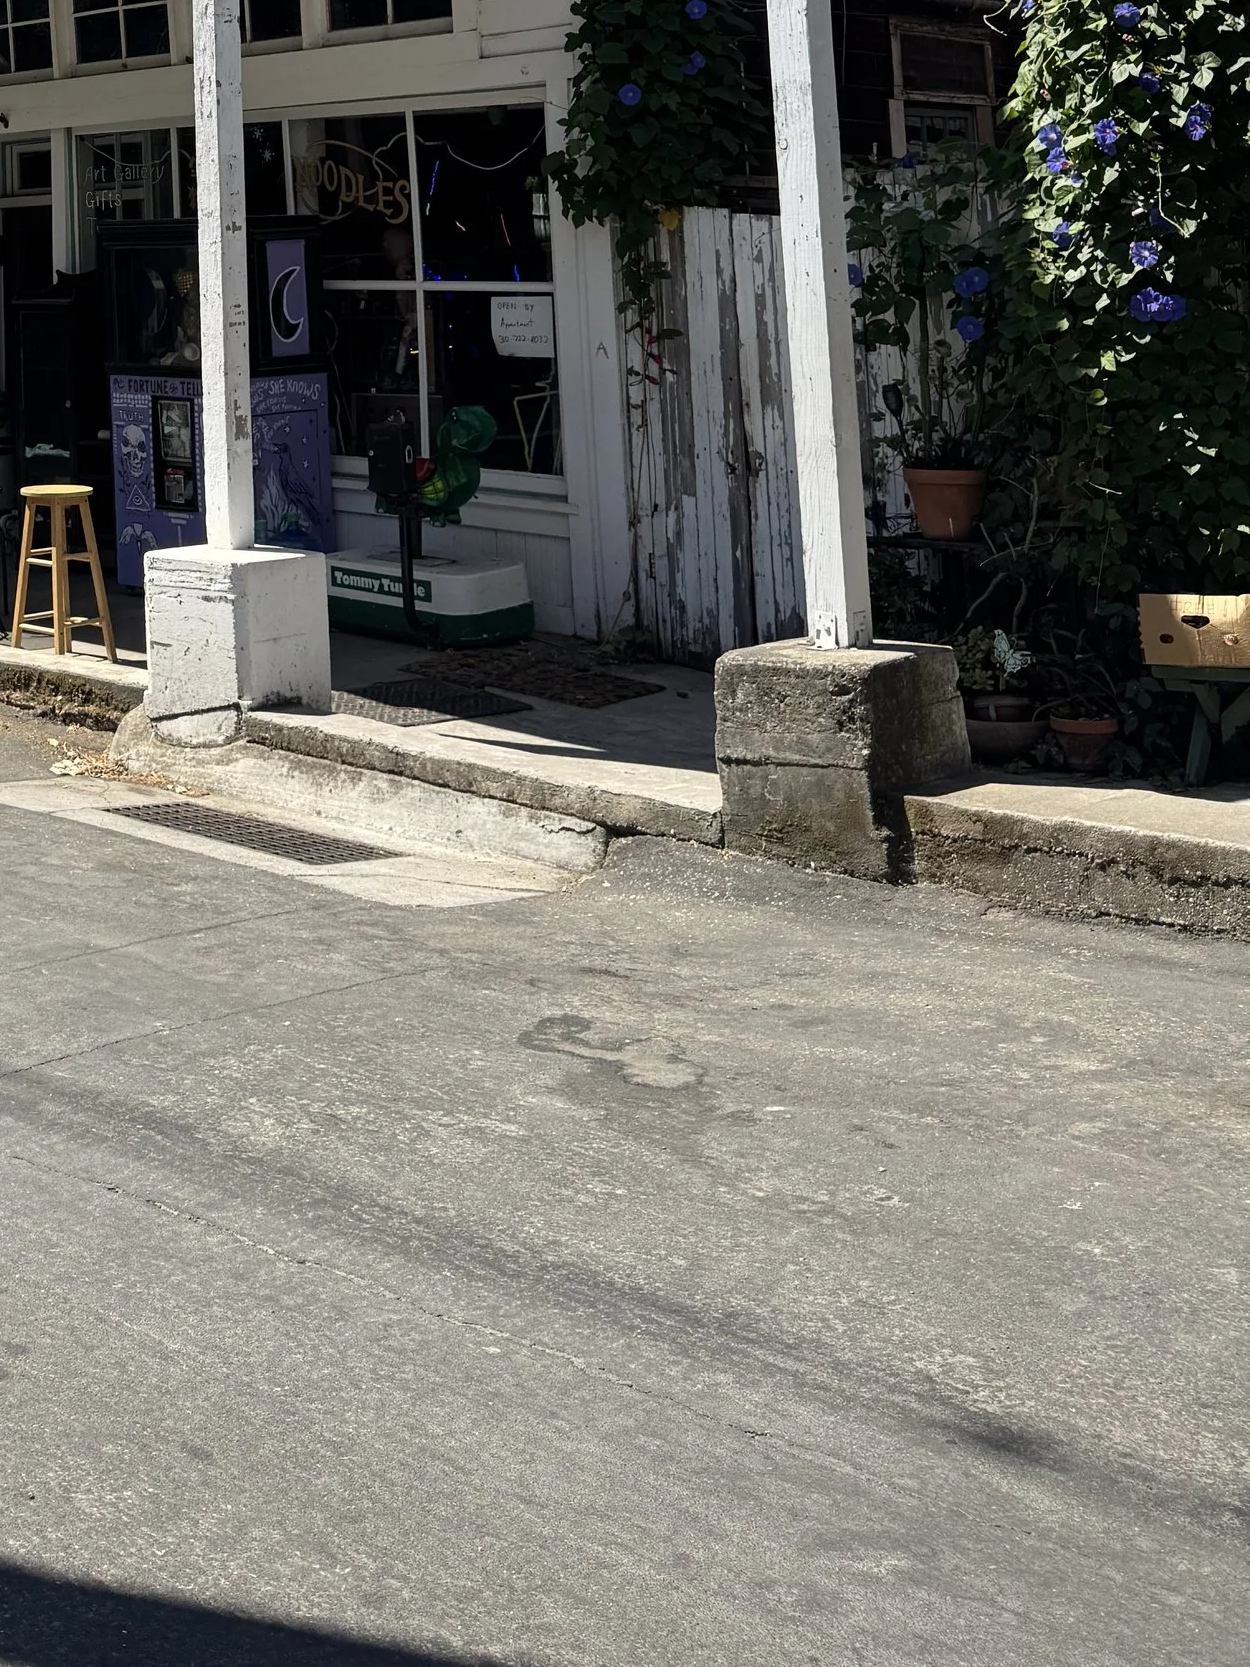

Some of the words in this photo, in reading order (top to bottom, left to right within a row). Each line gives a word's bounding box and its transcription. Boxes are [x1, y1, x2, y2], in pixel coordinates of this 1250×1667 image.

[82, 165, 107, 185] Art
[113, 164, 165, 185] Gallery
[85, 190, 123, 211] Gifts
[293, 157, 411, 225] NOODLES
[497, 302, 517, 310] OPEN
[128, 379, 169, 394] FORTUNE
[269, 379, 285, 394] SHE
[286, 378, 321, 400] KNOWS
[119, 409, 144, 422] TRUTH
[333, 570, 381, 592] Tommy
[381, 577, 426, 597] Turle
